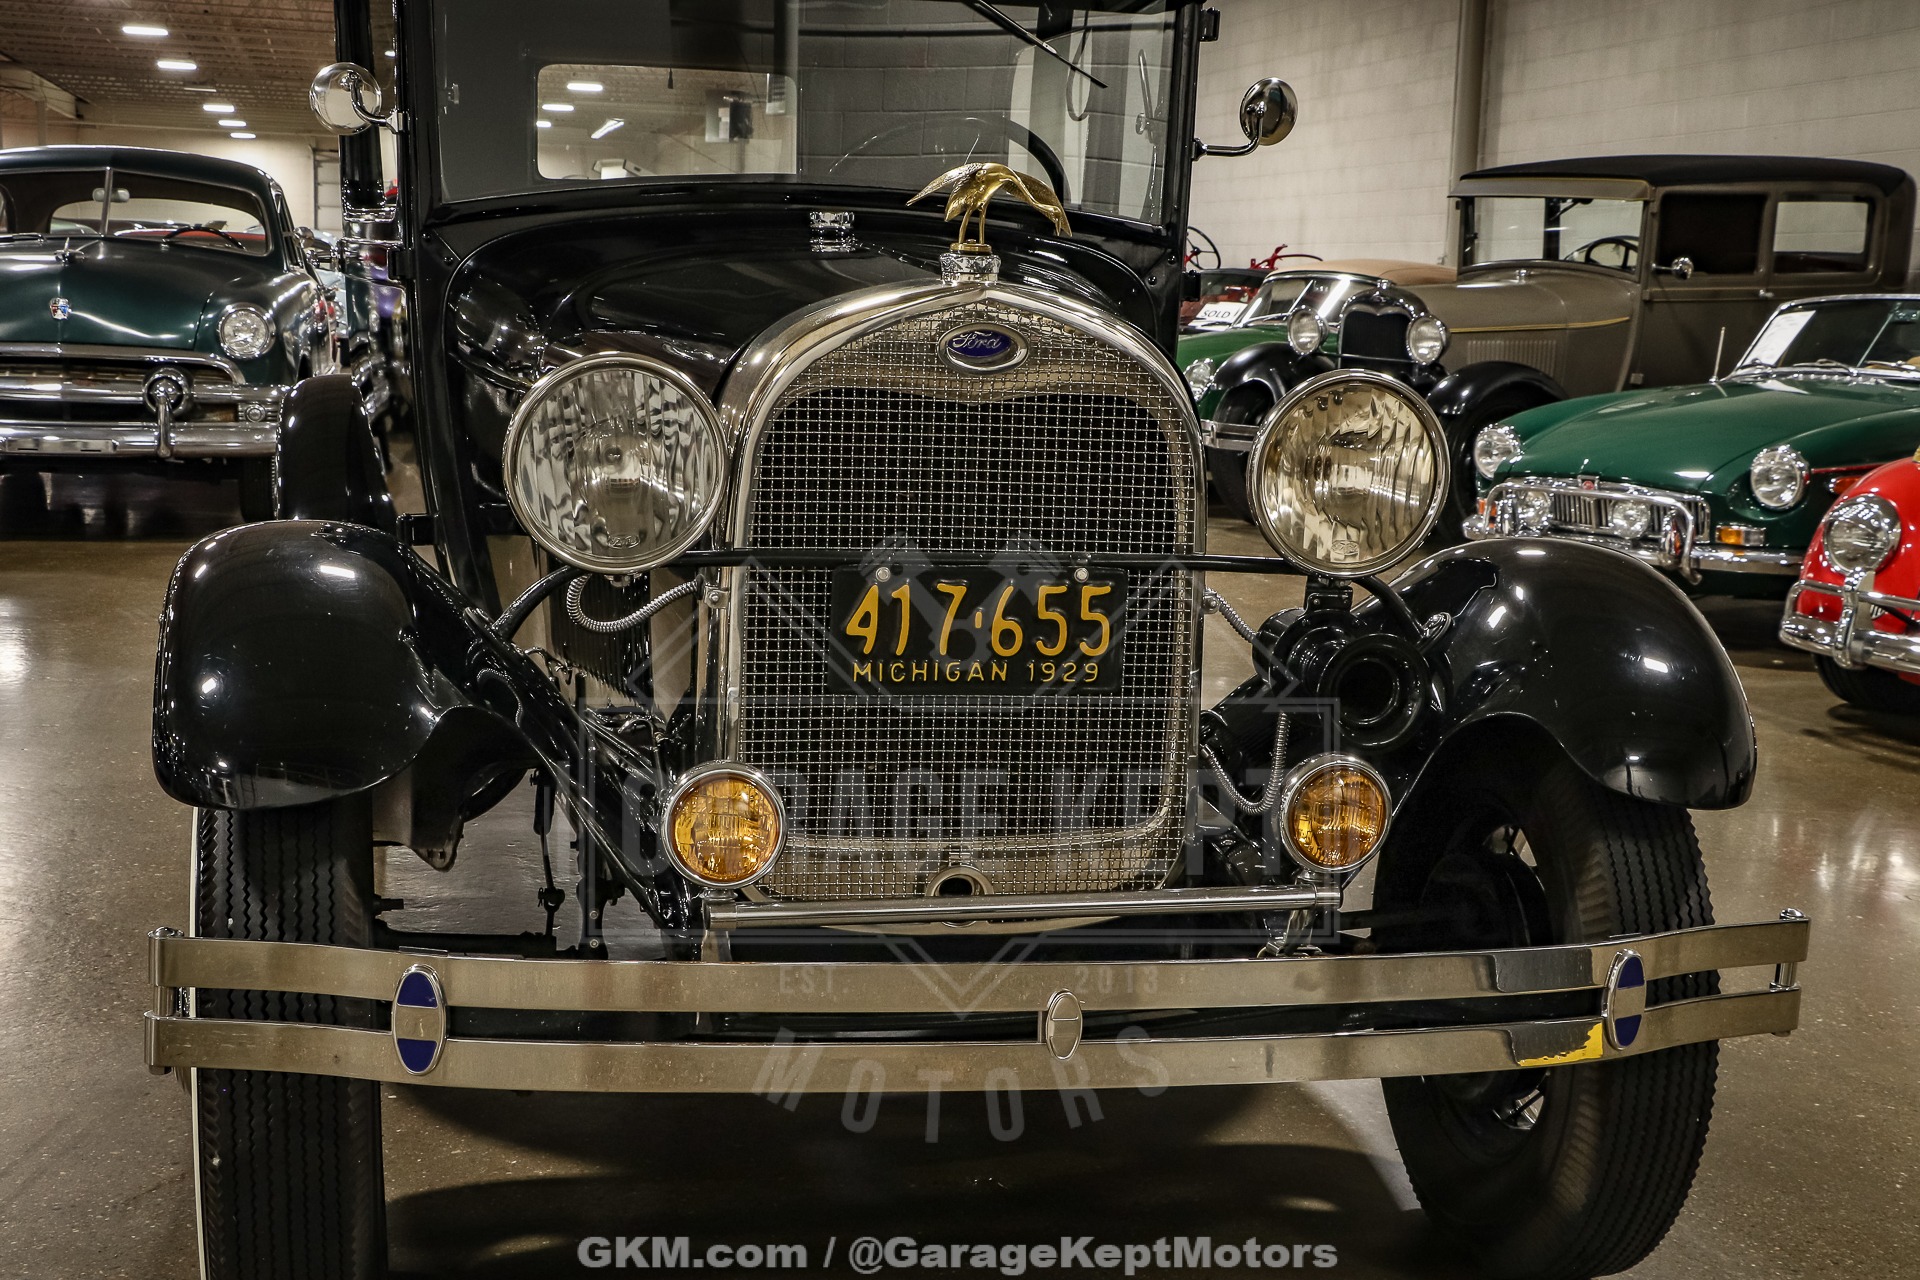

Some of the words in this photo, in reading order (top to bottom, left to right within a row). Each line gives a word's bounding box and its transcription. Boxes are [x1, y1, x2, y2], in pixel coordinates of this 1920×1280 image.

[1201, 309, 1231, 318] SOLD
[953, 331, 1002, 349] Ford
[853, 661, 1008, 682] MICHIGAN
[1027, 661, 1099, 682] 1929
